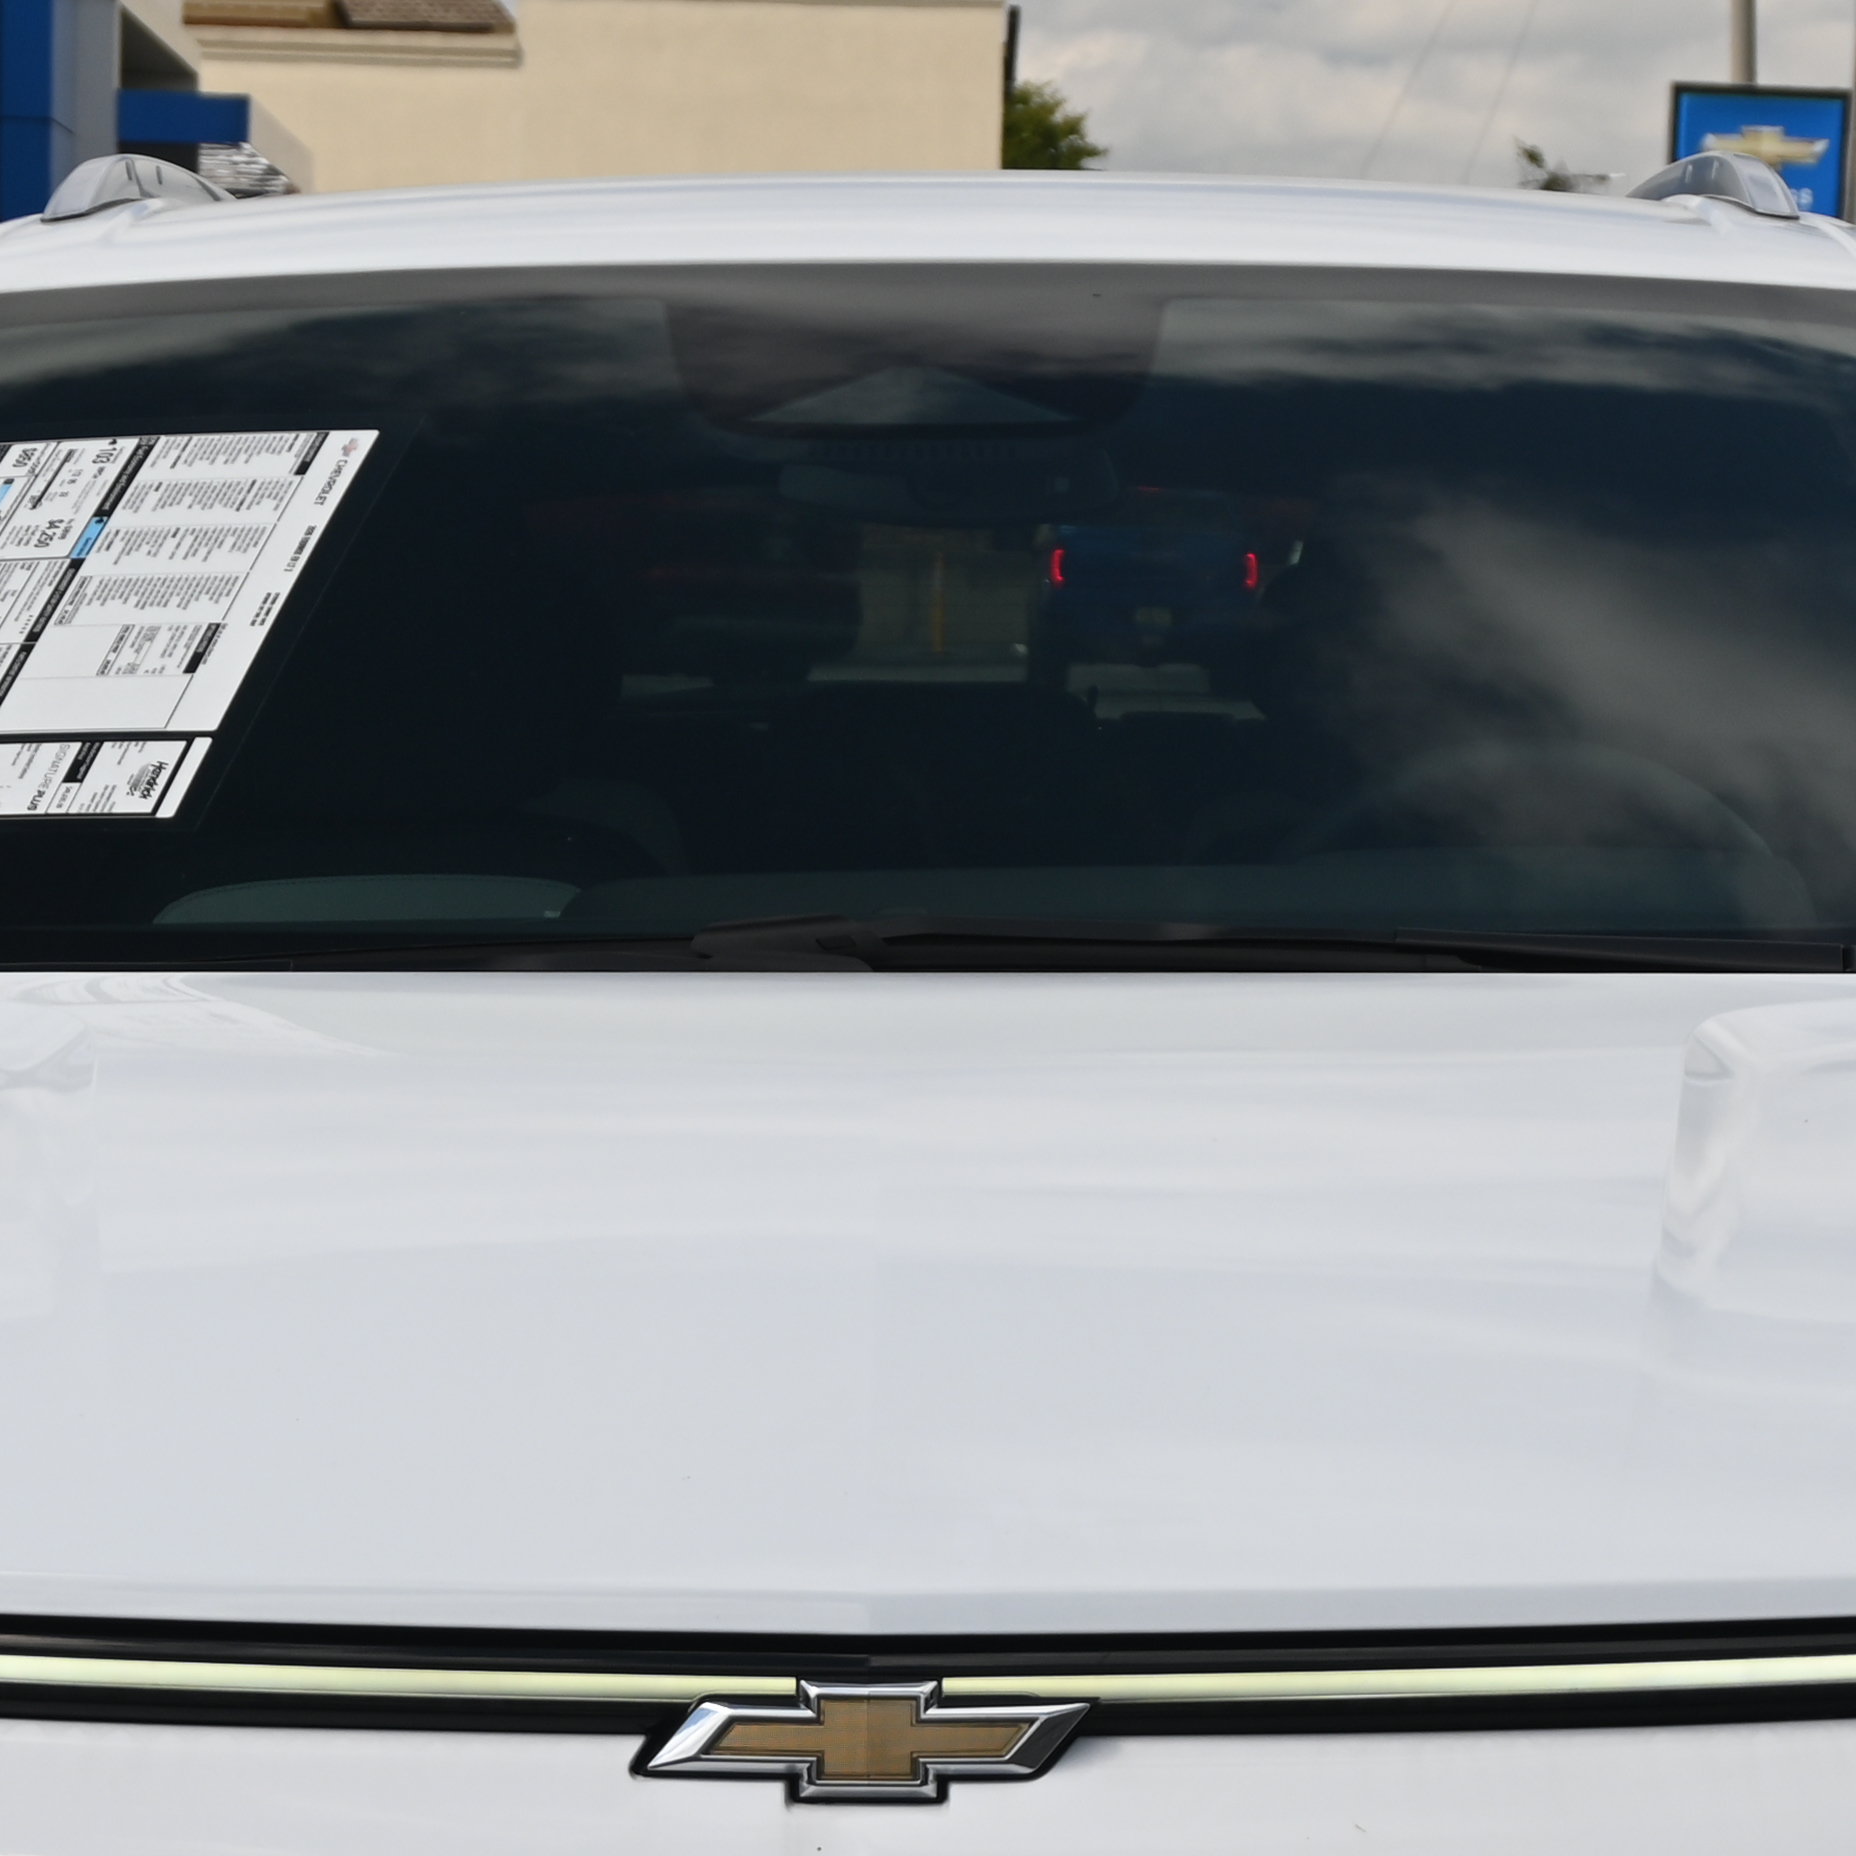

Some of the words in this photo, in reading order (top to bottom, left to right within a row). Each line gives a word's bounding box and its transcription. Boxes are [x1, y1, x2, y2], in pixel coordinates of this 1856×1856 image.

[92, 447, 117, 464] 103
[314, 460, 348, 505] CHEVROLET
[34, 519, 64, 548] $4,250
[138, 761, 169, 799] Hendrick
[27, 790, 46, 811] PLUS
